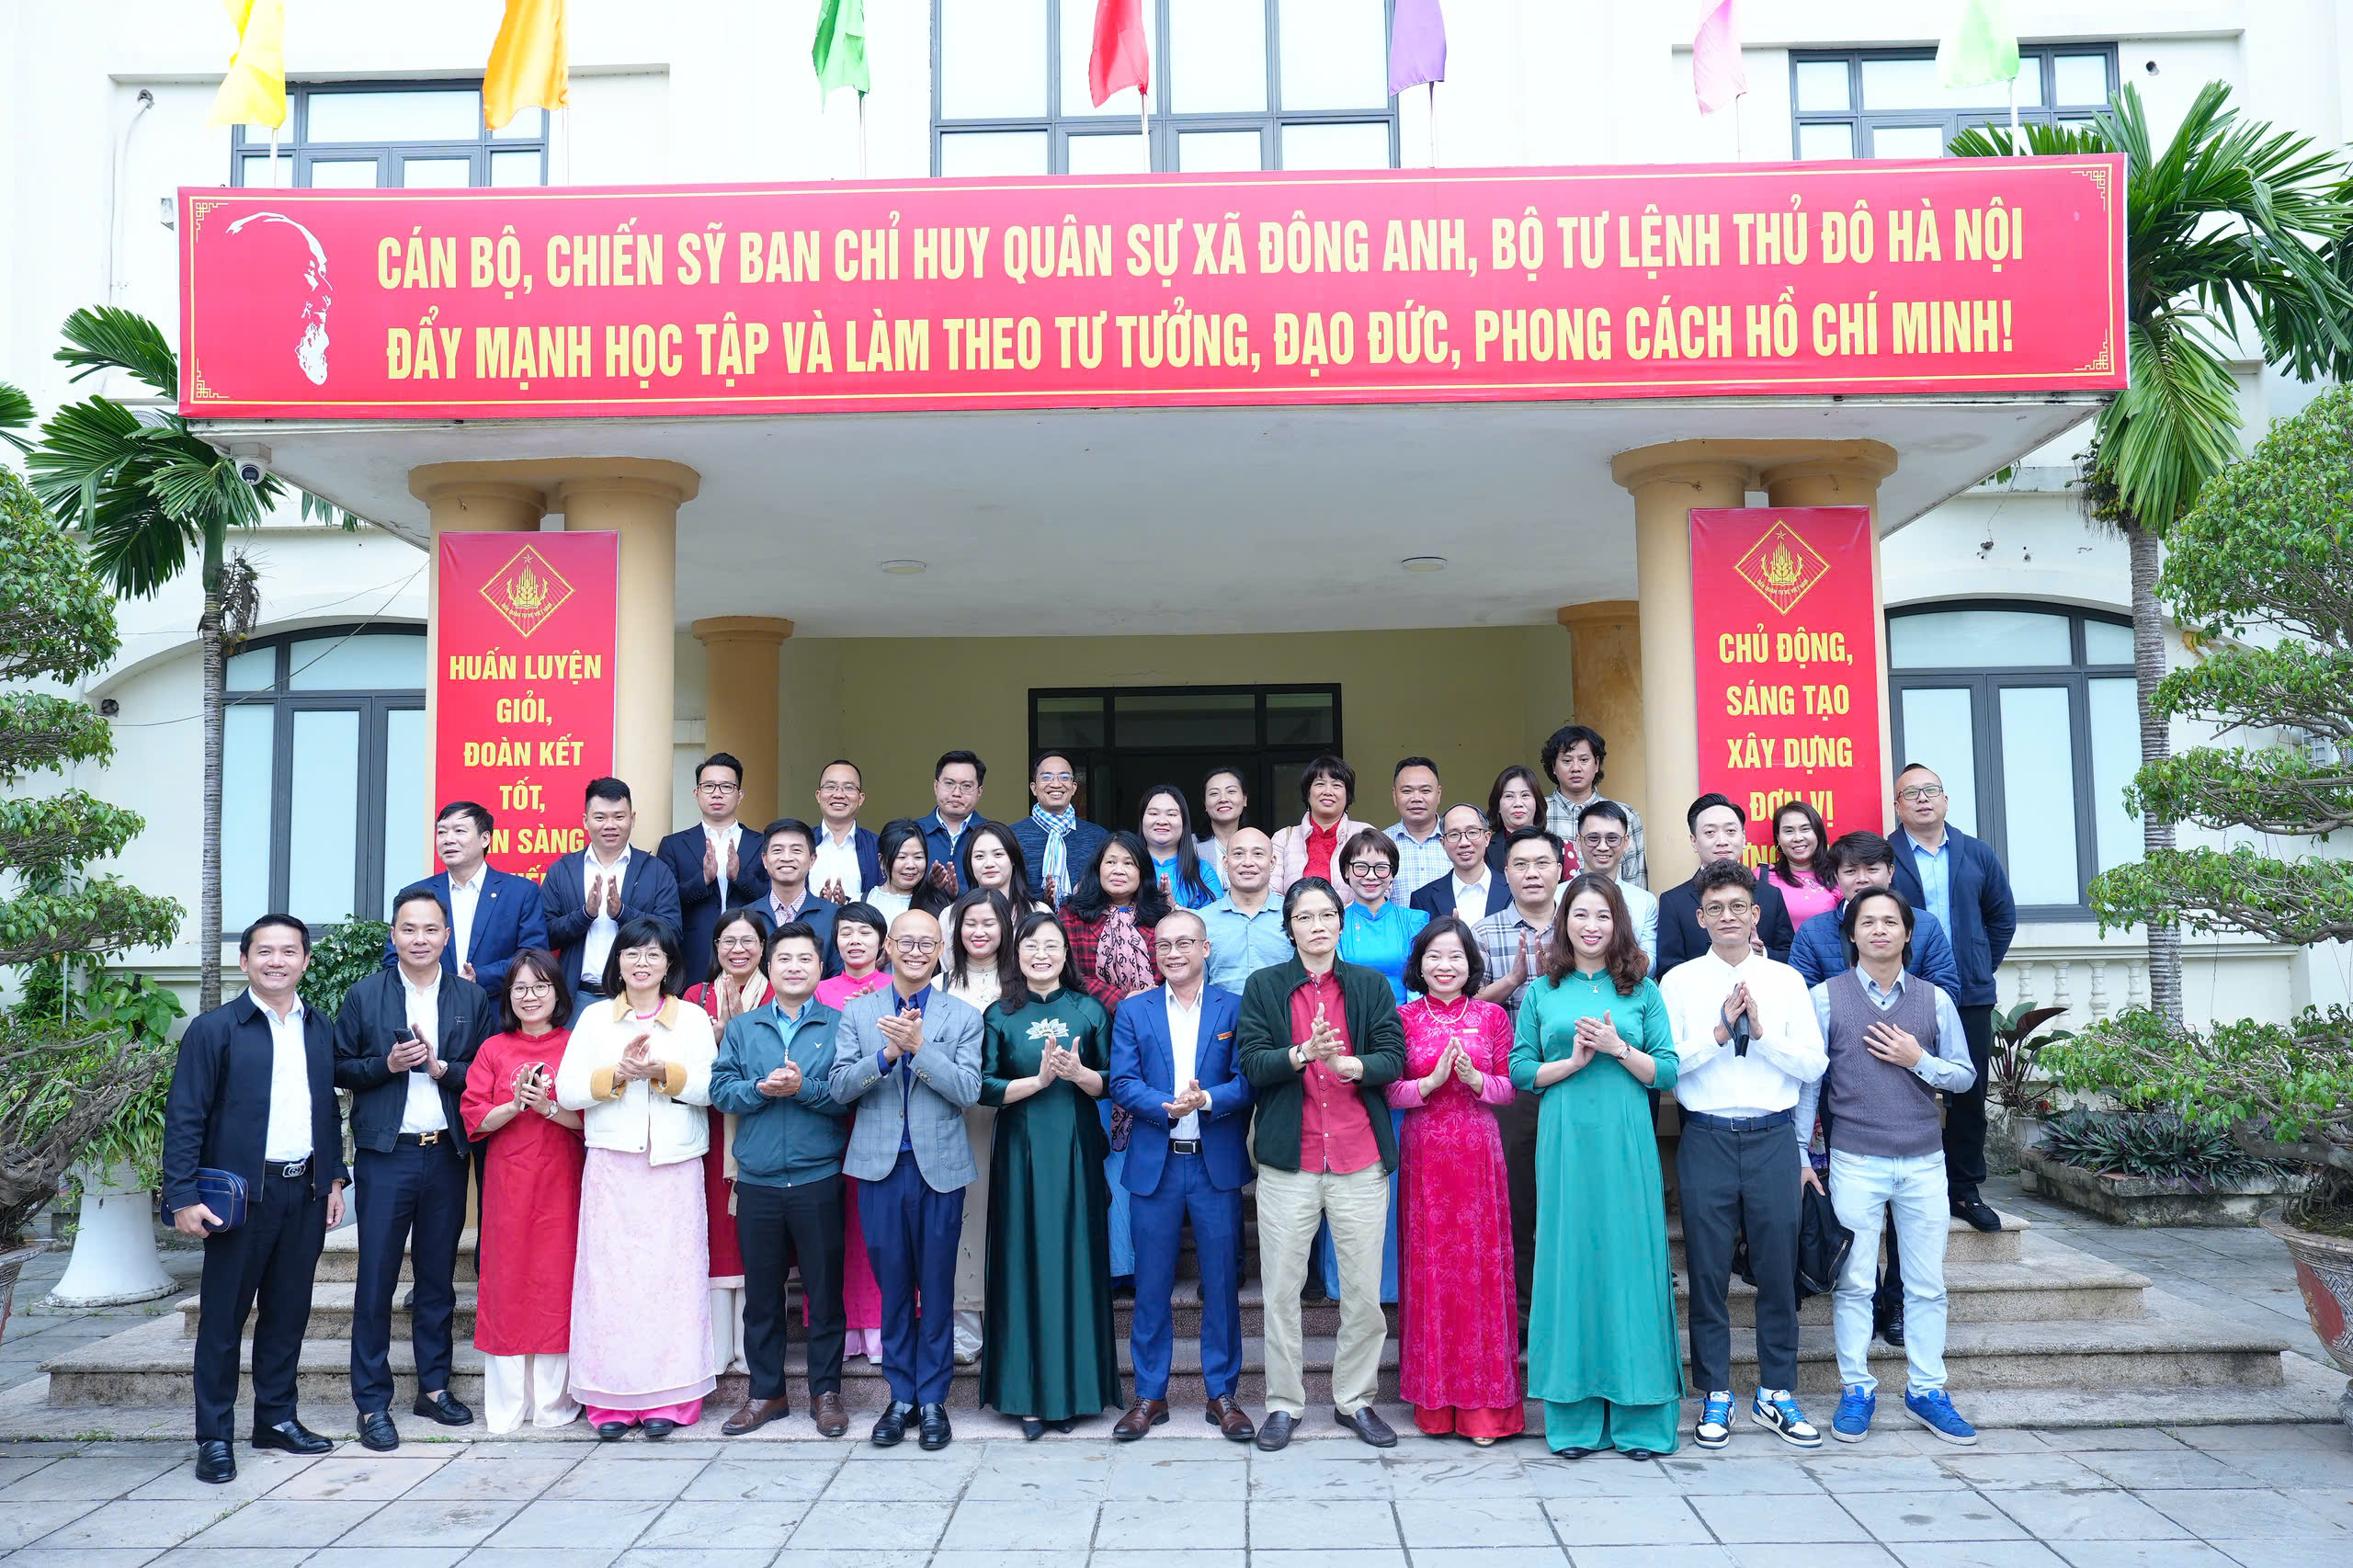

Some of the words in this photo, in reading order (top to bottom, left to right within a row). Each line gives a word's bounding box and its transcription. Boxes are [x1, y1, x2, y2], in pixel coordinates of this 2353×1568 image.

[378, 225, 457, 290] CÁN
[470, 224, 533, 300] BỘ,
[547, 217, 664, 288] CHIẾN
[677, 222, 727, 286] SỸ
[740, 230, 820, 284] BAN
[835, 210, 901, 282] CHỈ
[914, 226, 991, 280] HUY
[1004, 213, 1112, 285] QUÂN
[1126, 218, 1184, 288] SỰ
[1192, 211, 1246, 275] XÃ
[1257, 210, 1369, 274] ĐÔNG
[1381, 218, 1478, 278] ANH,
[1492, 205, 1544, 282] BỘ
[1556, 210, 1610, 269] TƯ
[1619, 203, 1720, 280] LỆNH
[1733, 193, 1808, 266] THỦ
[1820, 199, 1874, 264] ĐÔ
[1888, 198, 1942, 263] HÀ
[1954, 196, 2023, 273] NỘI
[386, 305, 462, 380] ĐẨY
[475, 325, 591, 391] MẠNH
[606, 324, 683, 389] HỌC
[695, 311, 769, 387] TẬP
[782, 309, 834, 374] VÀ
[846, 308, 929, 372] LÀM
[942, 316, 1041, 370] THEO
[1054, 310, 1108, 369] TƯ
[1115, 296, 1260, 373] TƯỞNG,
[1273, 311, 1354, 377] ĐẠO
[1367, 299, 1461, 369] ĐỨC,
[1474, 307, 1611, 362] PHONG
[1626, 294, 1733, 360] CÁCH
[1745, 285, 1799, 358] HỒ
[1813, 290, 1878, 357] CHÍ
[1892, 300, 2013, 355] MINH!
[1719, 622, 1769, 664] CHỦ
[1776, 626, 1854, 669] ĐỘNG,
[449, 646, 517, 681] HUẤN
[524, 649, 602, 686] LUYỆN
[496, 689, 552, 726] GIỎI,
[1726, 679, 1795, 716] SÁNG
[1802, 684, 1850, 722] TẠO
[463, 736, 531, 767] ĐOÀN
[539, 733, 585, 767] KẾT
[1726, 732, 1776, 769] XÂY
[1783, 734, 1853, 775] DỰNG
[499, 776, 546, 813] TỐT,
[1809, 790, 1834, 827] VỊ
[517, 823, 585, 854] SÀNG
